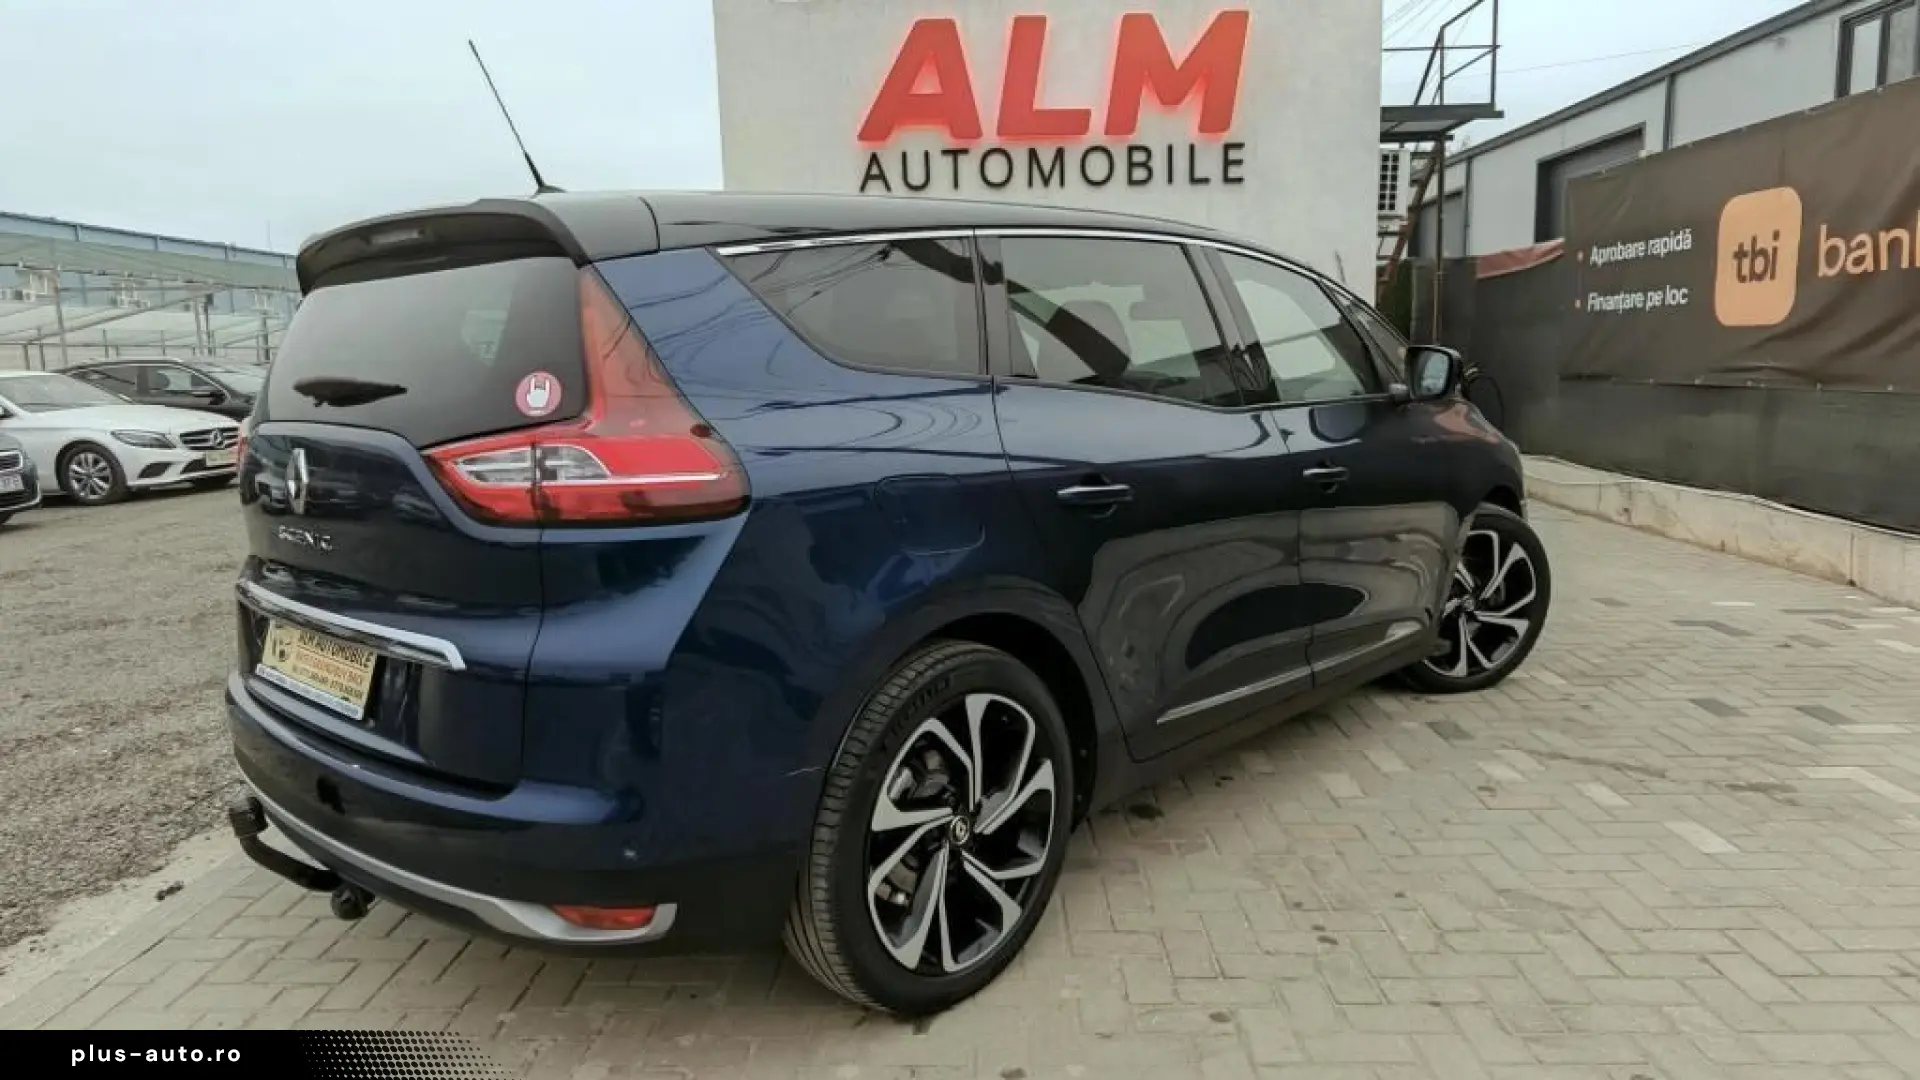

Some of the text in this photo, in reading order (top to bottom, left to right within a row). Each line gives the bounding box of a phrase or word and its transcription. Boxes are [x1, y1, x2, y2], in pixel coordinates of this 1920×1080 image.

[857, 10, 1250, 142] ALM
[859, 142, 1246, 193] AUTOMOBILE
[1590, 228, 1692, 268] Aprobare rapidă
[1733, 209, 1920, 284] tbi ban
[1646, 290, 1664, 312] pe
[1665, 284, 1689, 305] loc
[318, 636, 374, 669] AUTOMOBILE
